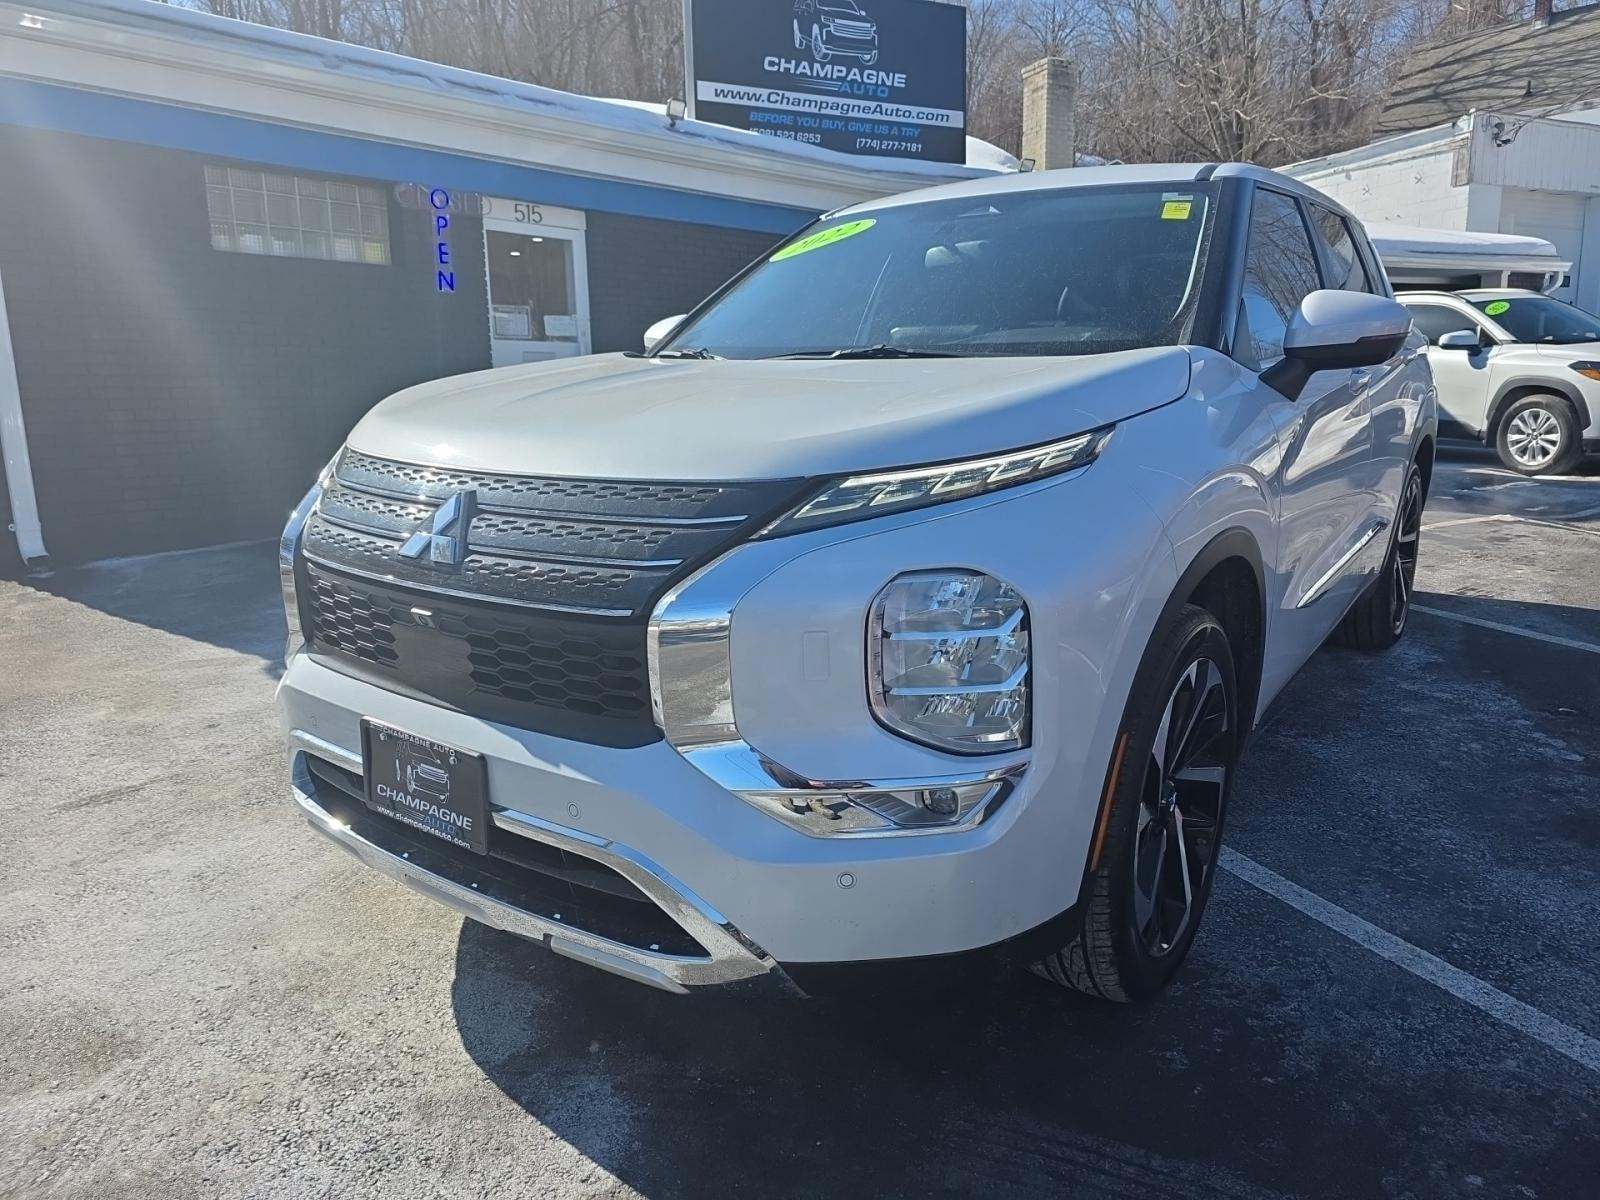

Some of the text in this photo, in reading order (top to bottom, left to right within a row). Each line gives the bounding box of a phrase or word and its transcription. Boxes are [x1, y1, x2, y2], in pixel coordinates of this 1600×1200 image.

[763, 56, 907, 88] CHAMPAGNE
[839, 83, 889, 98] AUTO
[714, 86, 951, 123] www.ChampagneAuto.com
[750, 111, 921, 137] BEFORE YOU BUY, GIVE US A TRY
[797, 132, 821, 143] 6253
[856, 138, 922, 153] (774) 277-7181
[514, 203, 543, 223] 515
[430, 188, 455, 291] OPEN
[383, 727, 456, 756] CHAMPAGNE AUTO
[376, 784, 473, 831] CHAMPAGNE
[424, 815, 457, 834] AUTO
